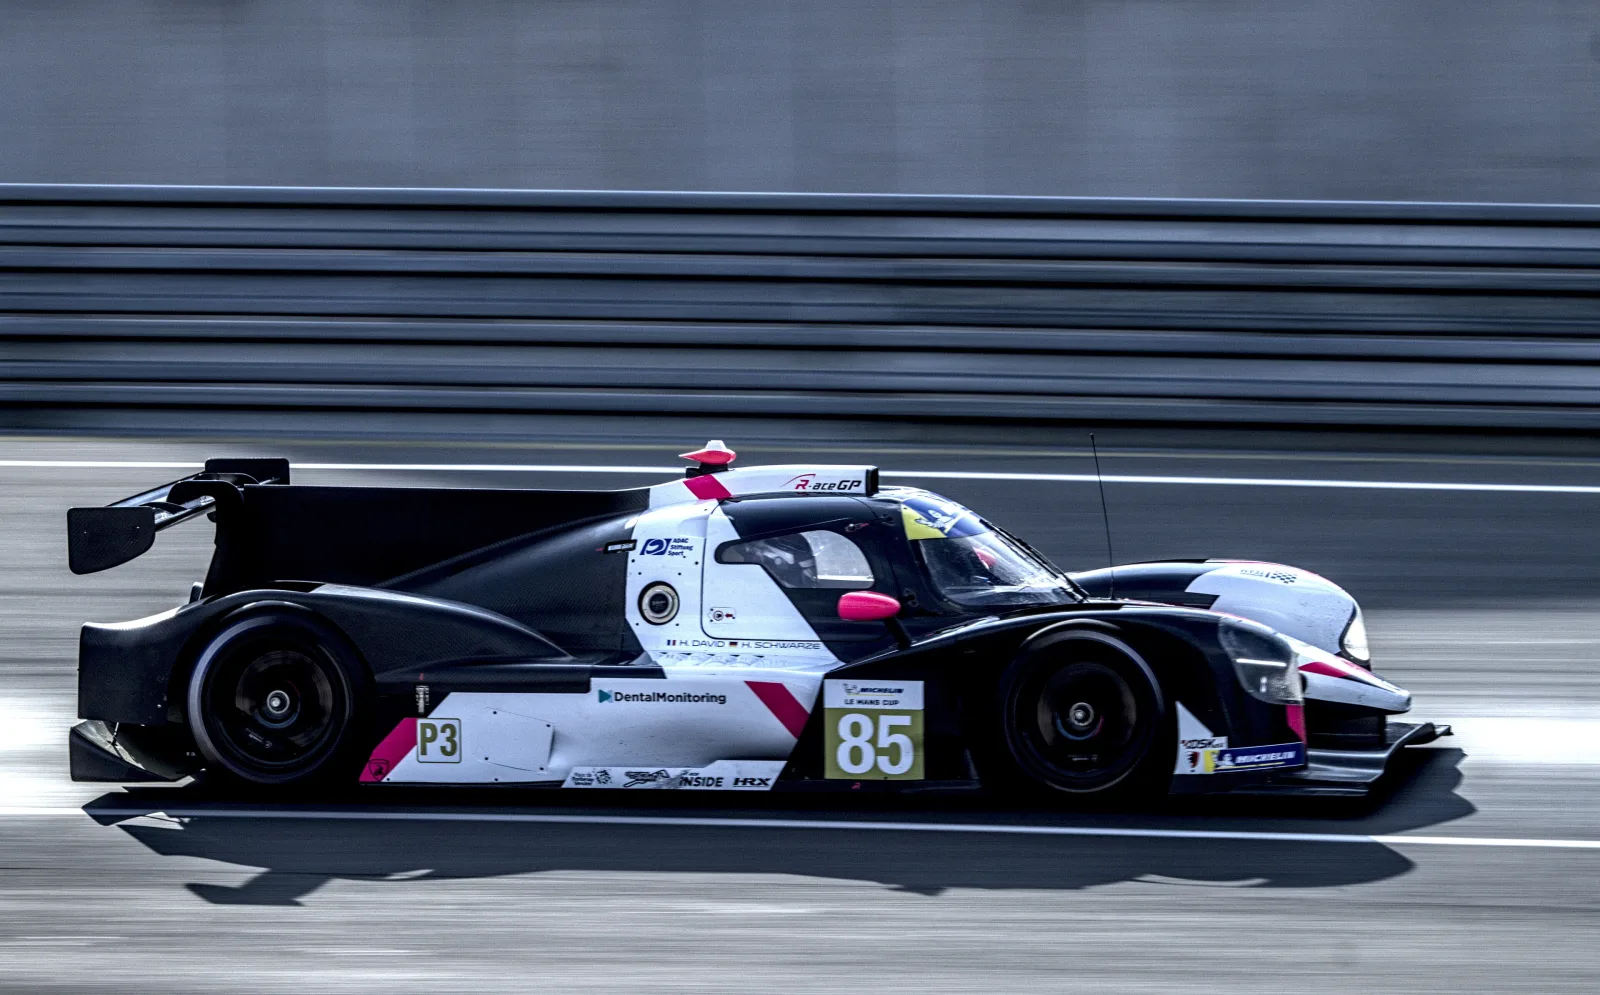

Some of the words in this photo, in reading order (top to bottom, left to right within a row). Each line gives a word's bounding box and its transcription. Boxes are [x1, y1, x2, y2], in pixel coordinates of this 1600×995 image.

[754, 642, 821, 650] SCHWARZE
[614, 691, 727, 705] DentalMonitoring
[420, 722, 458, 757] P3
[836, 713, 914, 775] 85
[1235, 751, 1296, 763] MICHELIN
